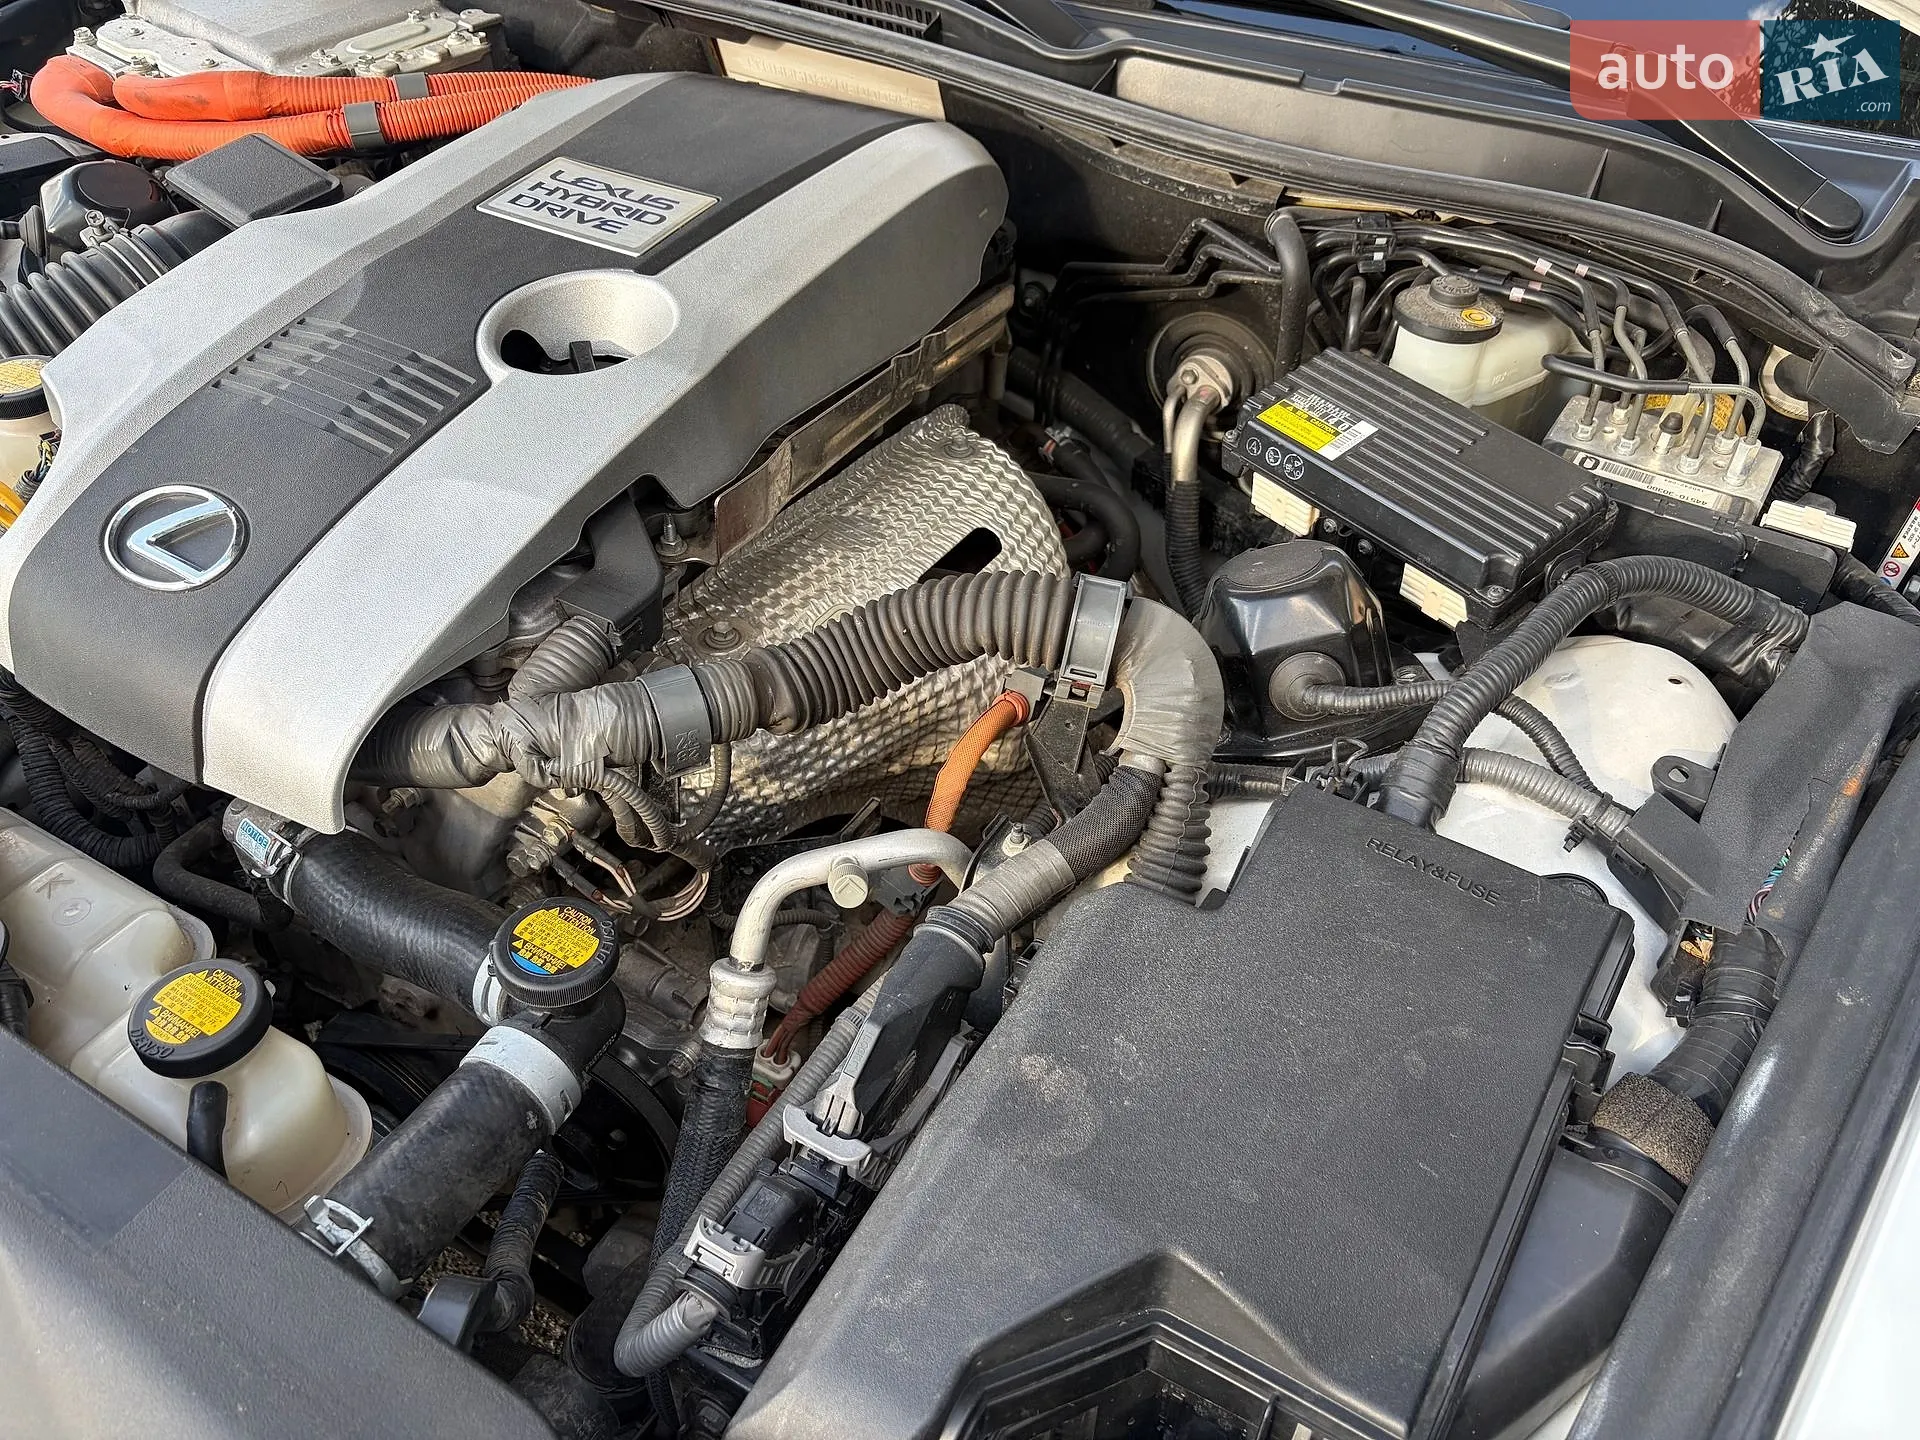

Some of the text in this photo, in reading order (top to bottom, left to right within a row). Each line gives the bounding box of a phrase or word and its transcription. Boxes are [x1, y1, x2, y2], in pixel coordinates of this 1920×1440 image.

[528, 181, 667, 226] HYBRID
[549, 169, 680, 211] LEXUS
[507, 193, 629, 234] DRIVE
[1310, 419, 1336, 434] CAUTION
[240, 821, 268, 848] NOTICE
[559, 913, 597, 935] ATTENTION
[563, 906, 594, 924] CAUTION
[596, 920, 615, 965] DENSO
[205, 976, 242, 1000] ATTENTION
[212, 969, 242, 989] CAUTION
[130, 1028, 175, 1059] DENSO
